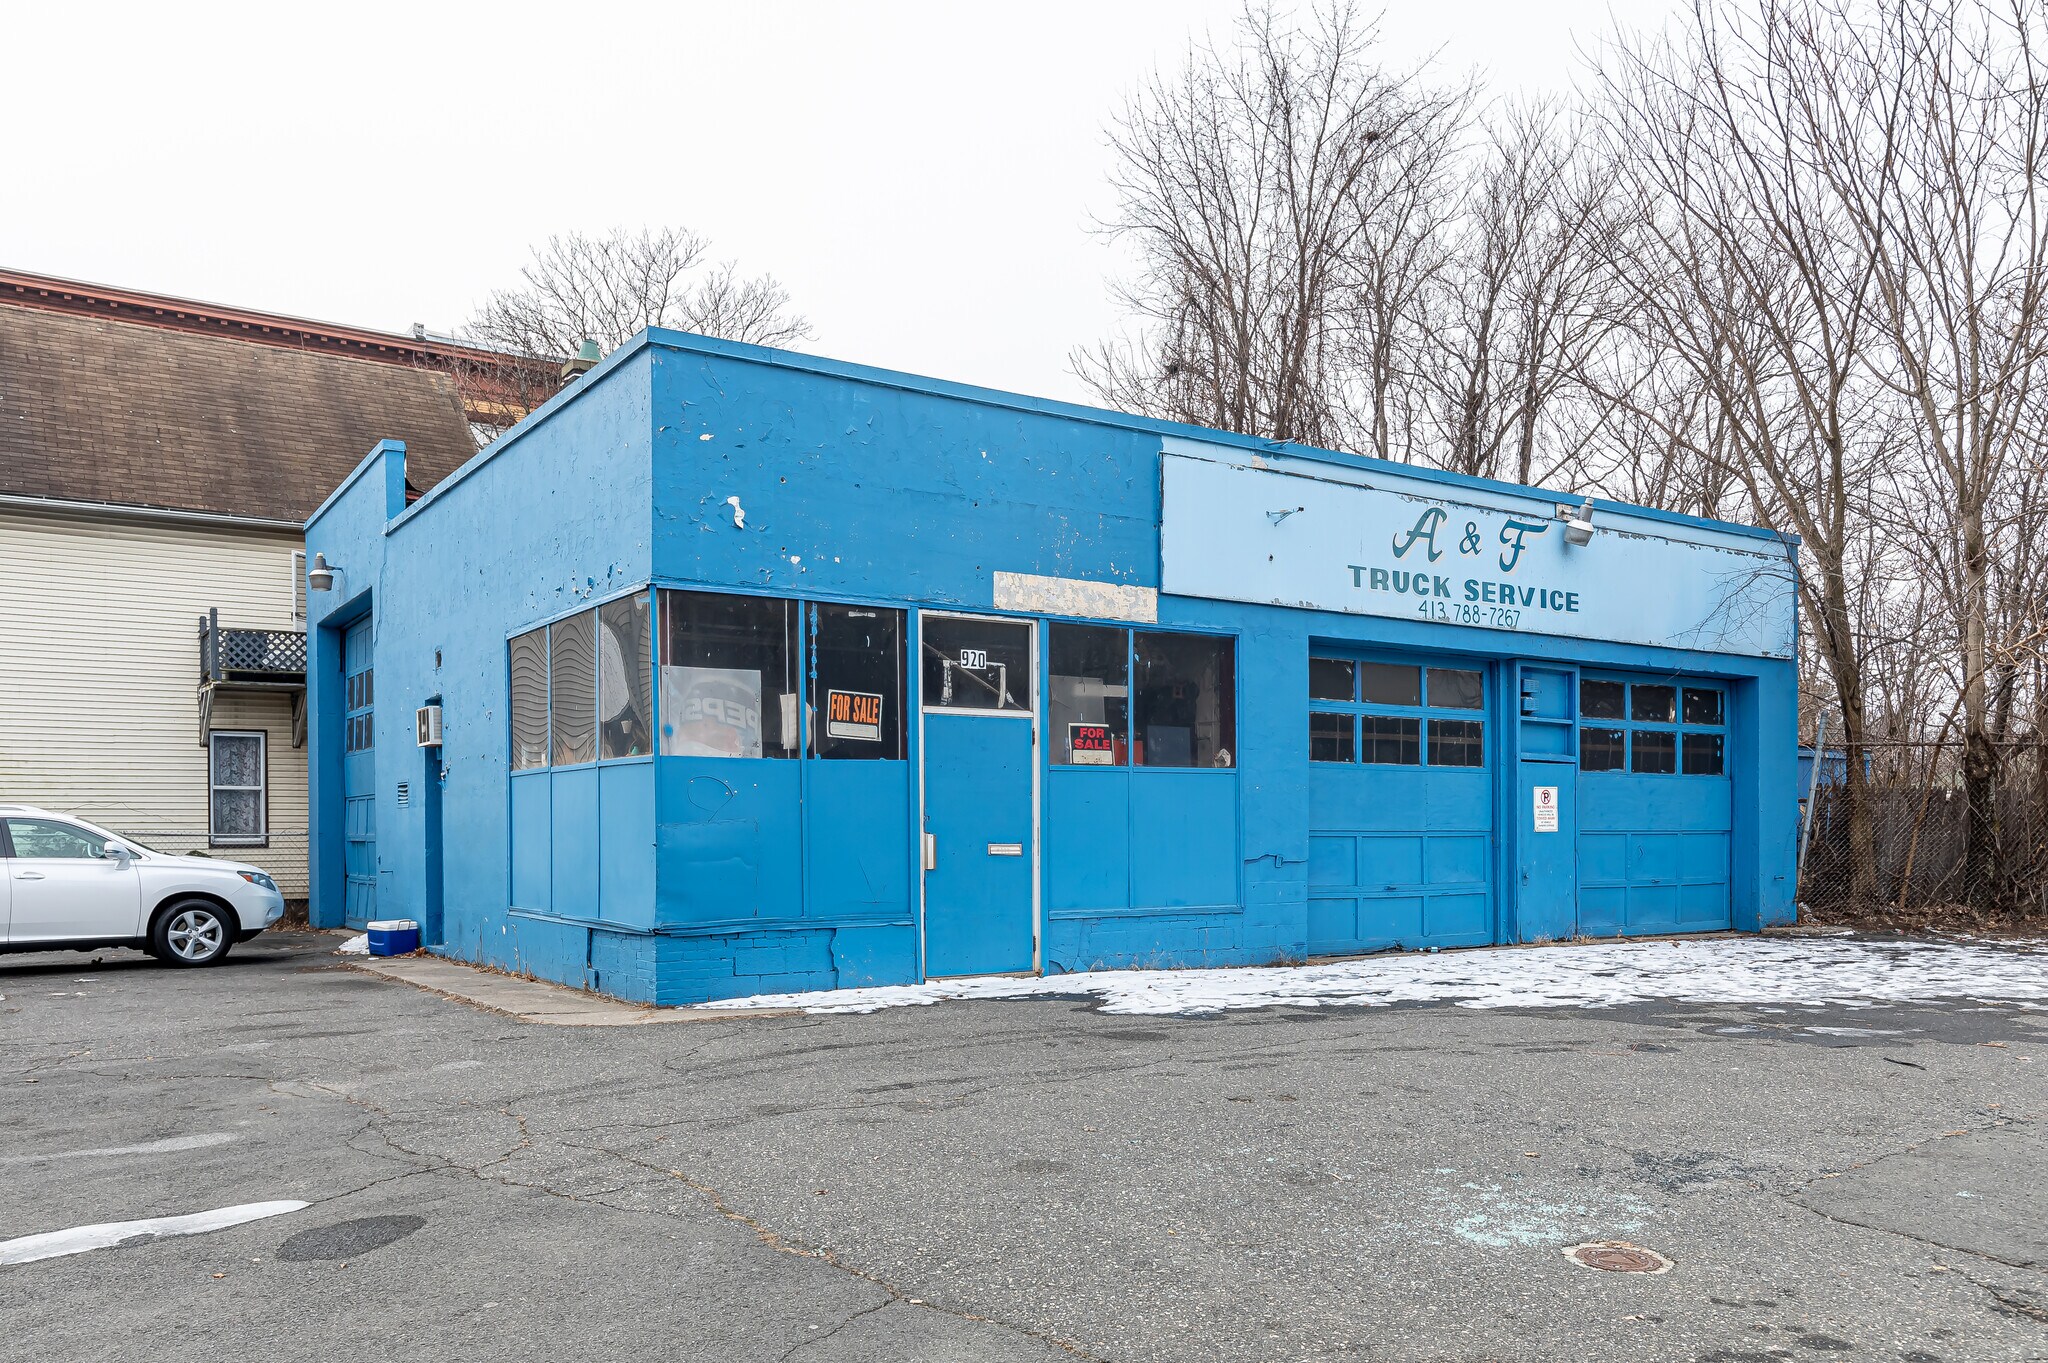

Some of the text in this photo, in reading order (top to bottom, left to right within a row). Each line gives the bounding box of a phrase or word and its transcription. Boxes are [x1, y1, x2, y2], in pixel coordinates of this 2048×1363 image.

[1392, 507, 1549, 573] A & F
[1347, 565, 1579, 612] TRUCK SERVICE
[1418, 600, 1520, 627] 413 788-7267
[961, 651, 986, 668] 920
[830, 693, 879, 724] FOR SALE
[1074, 738, 1111, 750] SALE
[1080, 727, 1105, 739] FOR
